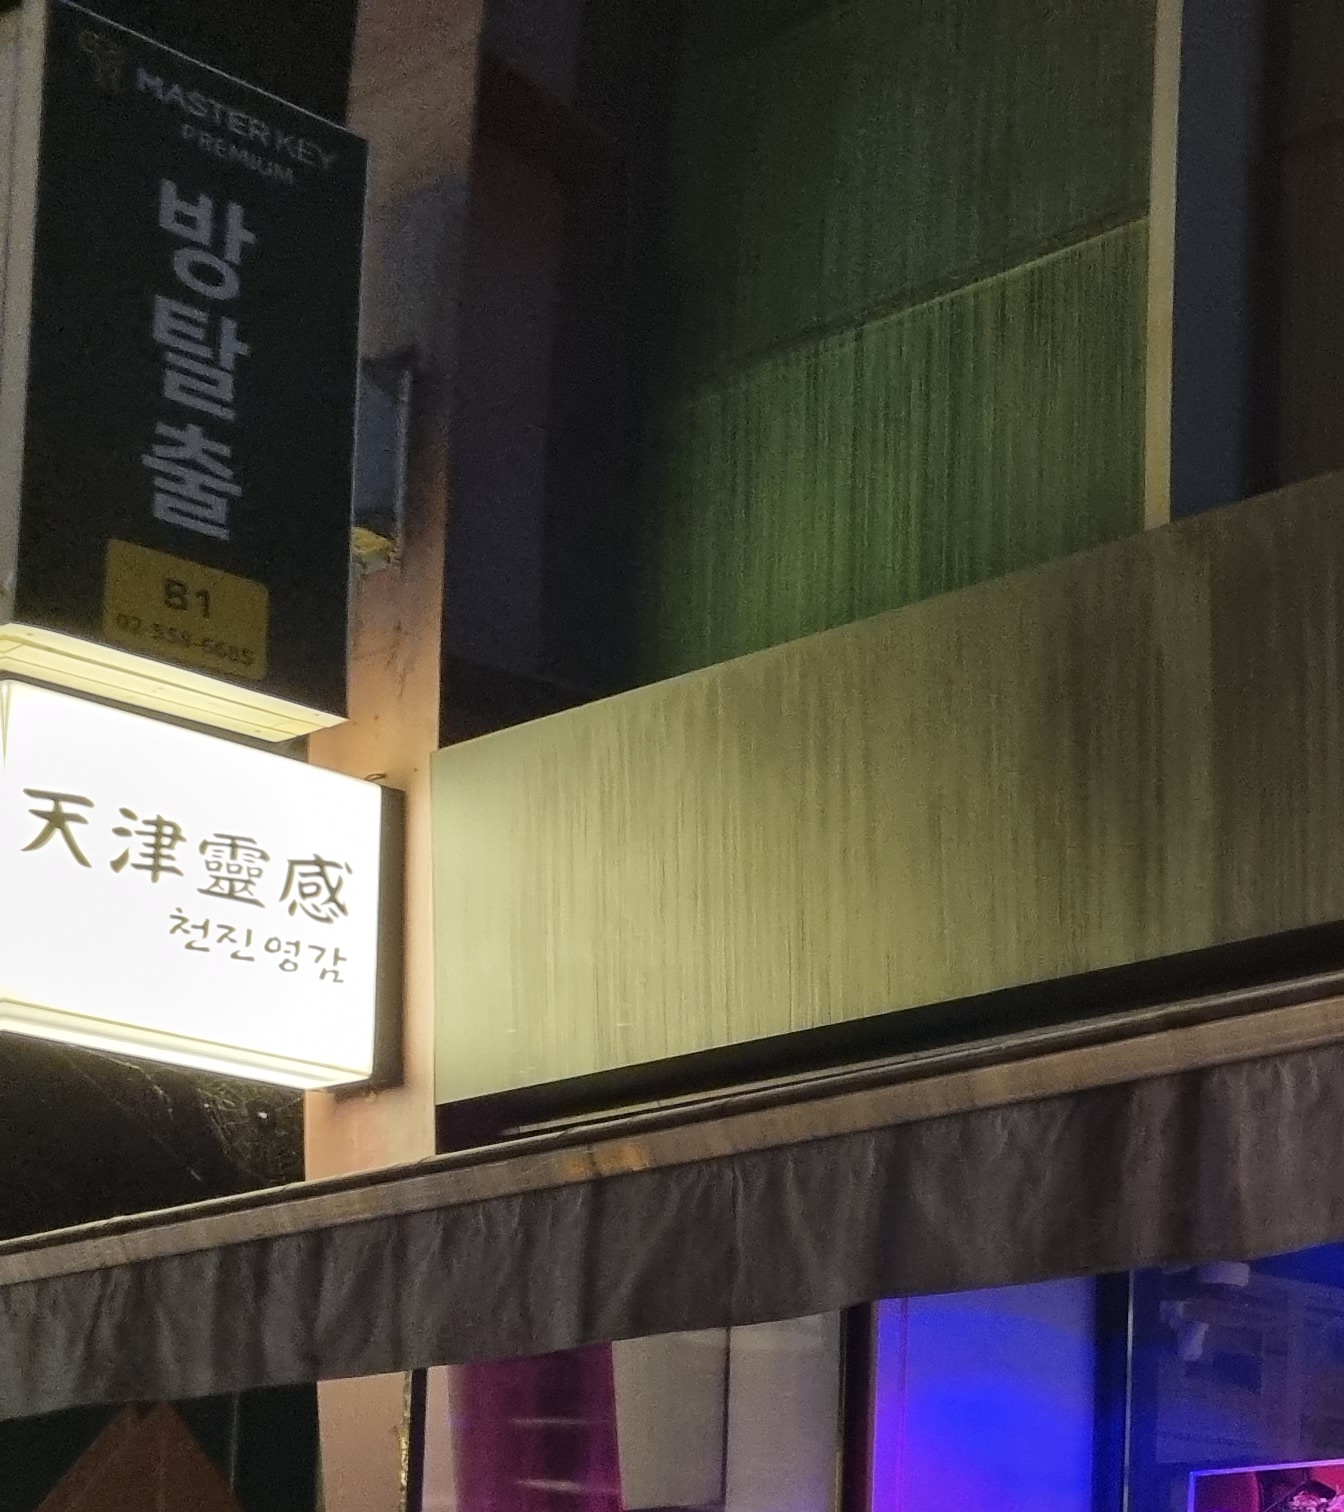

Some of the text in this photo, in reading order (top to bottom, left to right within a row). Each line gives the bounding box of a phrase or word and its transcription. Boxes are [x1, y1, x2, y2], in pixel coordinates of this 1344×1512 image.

[142, 178, 256, 540] 방탈출
[165, 578, 210, 619] B1
[20, 789, 353, 924] 天津靈感
[169, 907, 347, 983] 천진영감
